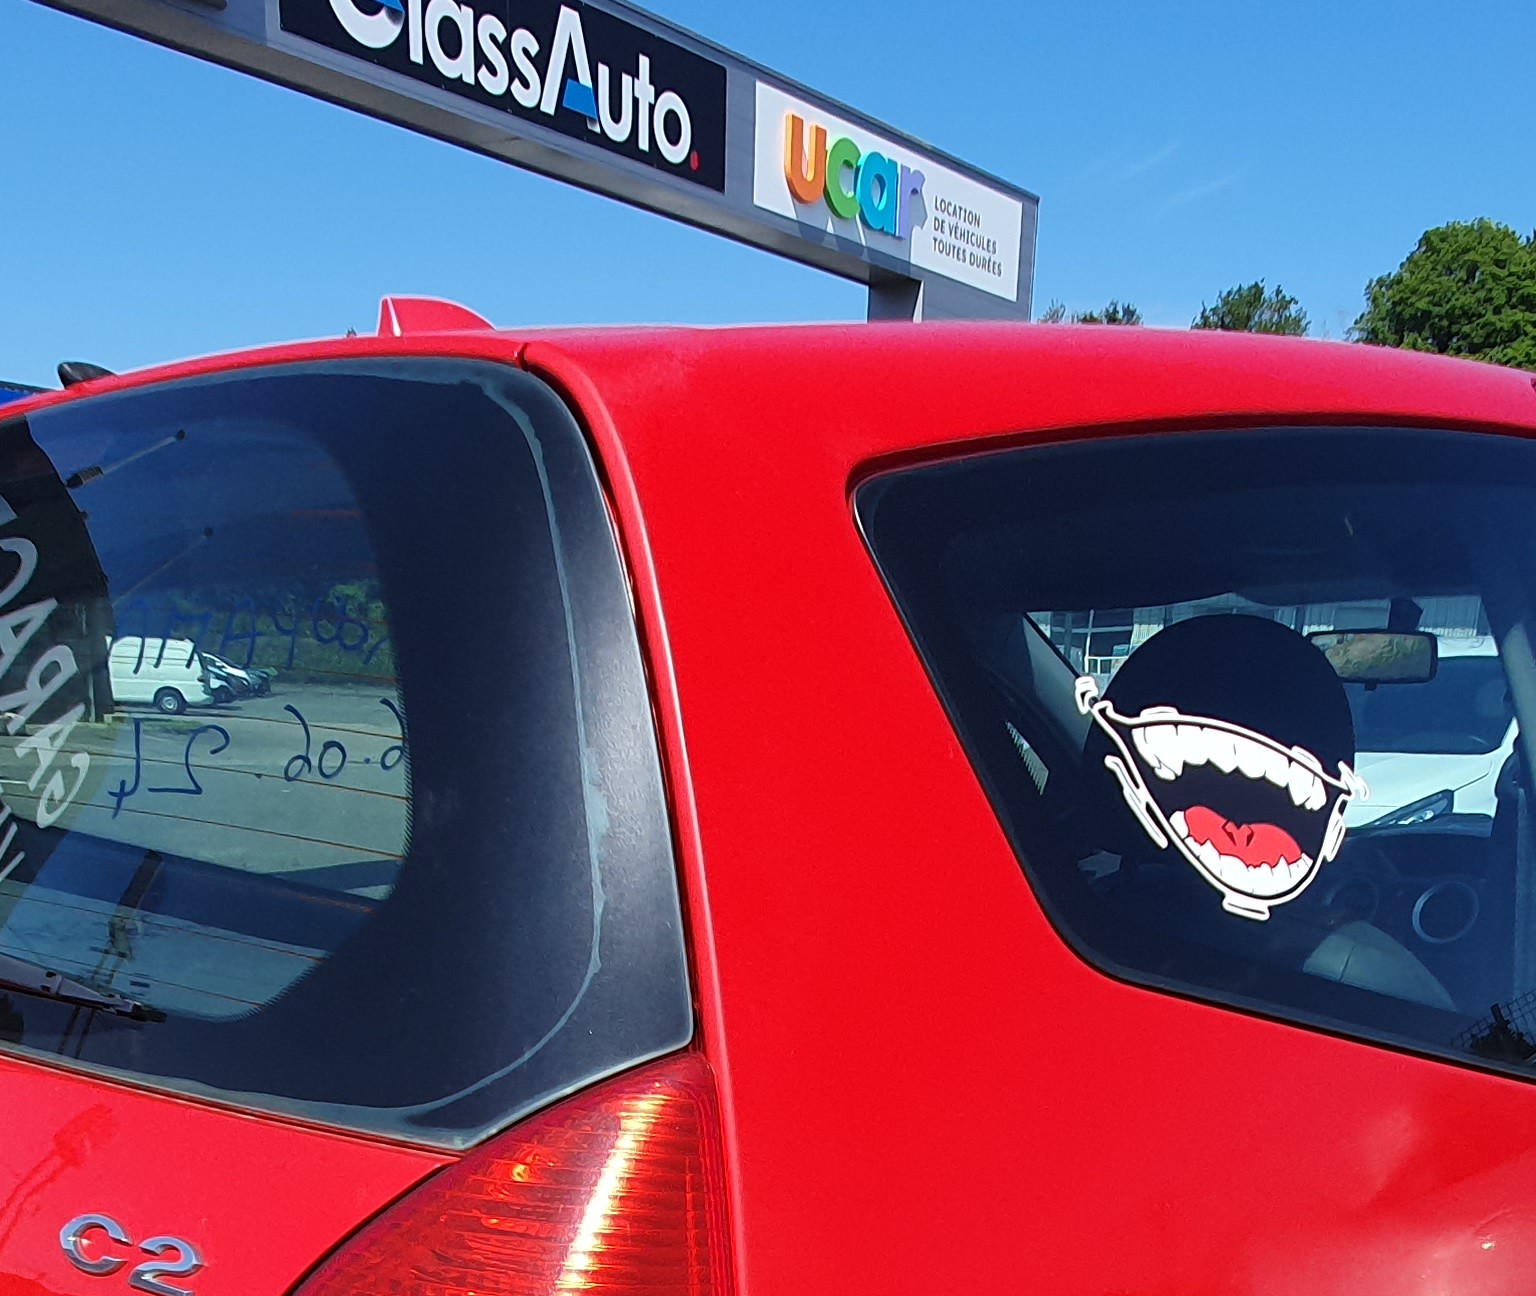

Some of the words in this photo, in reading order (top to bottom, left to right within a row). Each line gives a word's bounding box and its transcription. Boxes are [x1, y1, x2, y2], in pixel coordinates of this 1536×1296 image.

[784, 113, 926, 240] ucar
[934, 195, 981, 228] LOCATION
[933, 216, 945, 233] DE
[948, 219, 997, 255] VÉHICULES
[933, 236, 967, 263] TOUTES
[969, 253, 1002, 278] DURÉES
